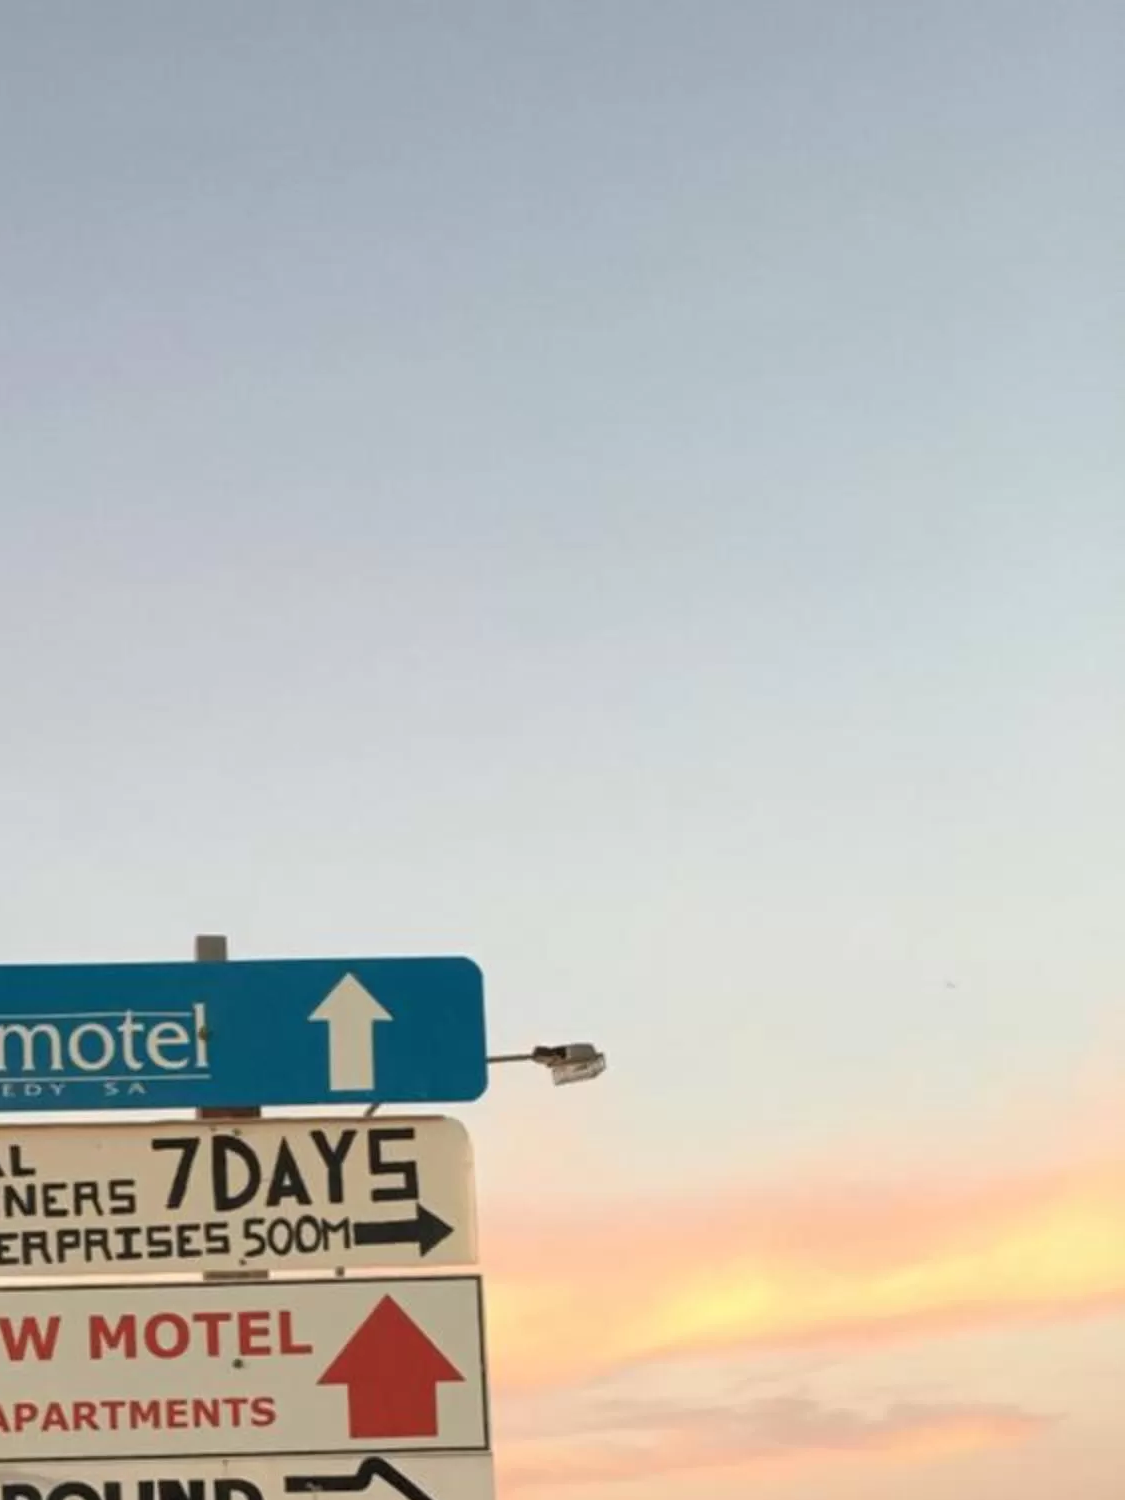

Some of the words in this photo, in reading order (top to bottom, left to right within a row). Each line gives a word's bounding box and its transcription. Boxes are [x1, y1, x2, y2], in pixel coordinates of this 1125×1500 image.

[105, 1082, 148, 1096] SA
[244, 1217, 351, 1258] 500M
[89, 1310, 313, 1360] MOTEL
